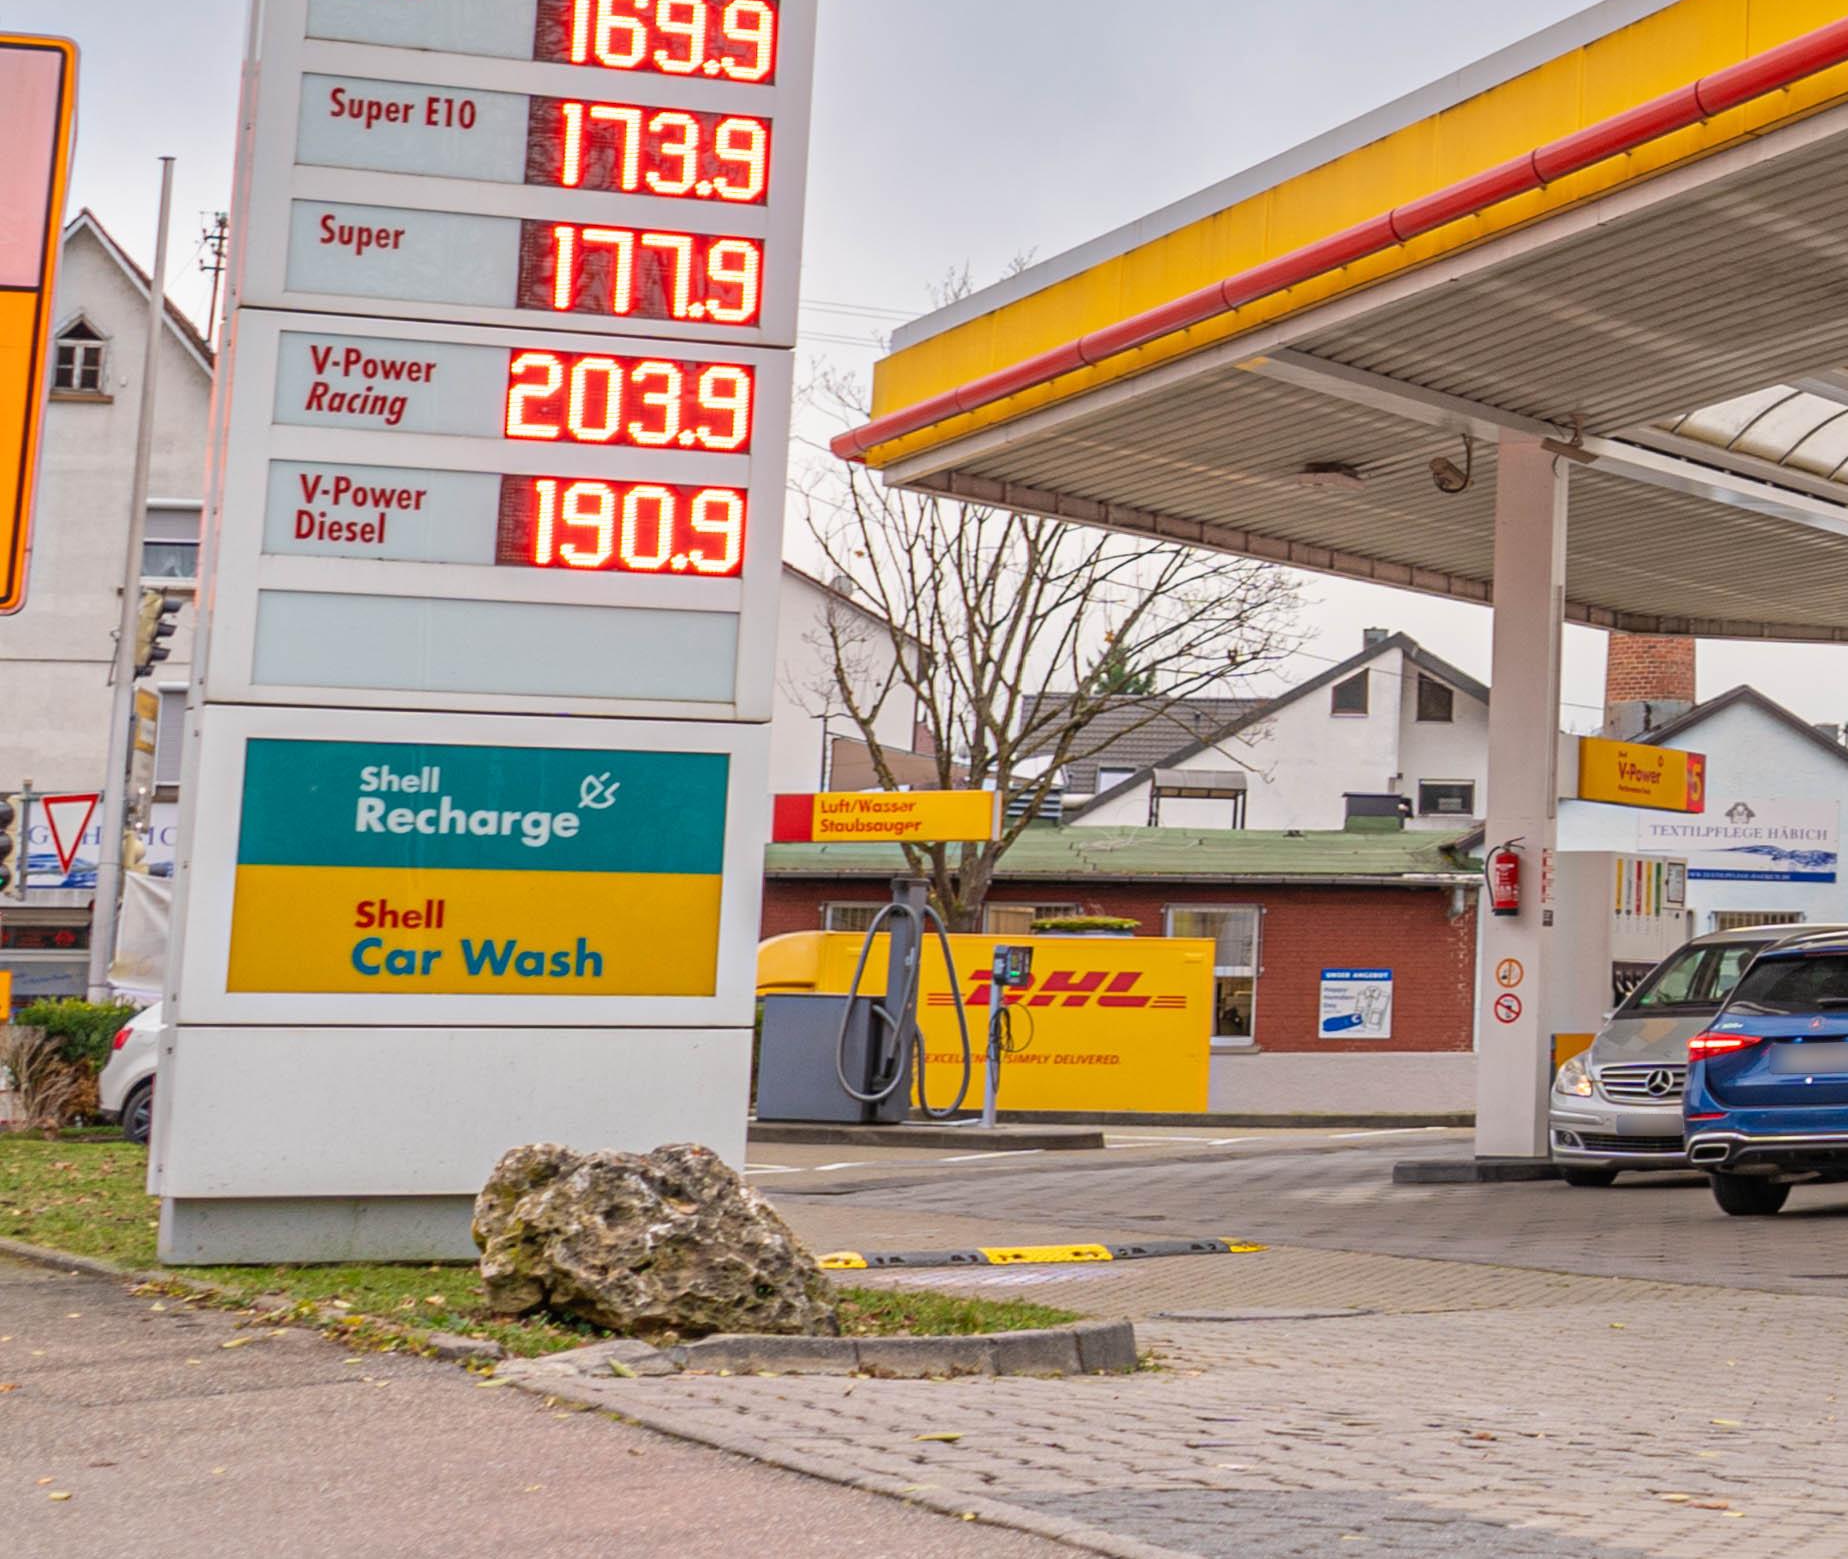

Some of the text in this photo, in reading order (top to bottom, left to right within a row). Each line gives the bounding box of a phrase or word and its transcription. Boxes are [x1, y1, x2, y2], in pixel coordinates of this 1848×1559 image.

[329, 88, 477, 130] Super E10
[560, 102, 769, 201] 173.9
[319, 214, 406, 256] Super
[552, 224, 762, 322] 177.9
[310, 345, 437, 383] V-Power
[304, 382, 408, 426] Racing
[505, 352, 751, 450] 203.9
[299, 473, 427, 511] V-Power
[293, 509, 387, 545] Diesel
[533, 478, 745, 573] 190.9
[359, 765, 441, 794] Shell
[1690, 762, 1701, 802] 5
[355, 795, 581, 848] Recharge
[820, 798, 917, 814] Luft/Wasser
[819, 817, 923, 836] Staubsauger
[1650, 823, 1828, 840] TEXTILPFLEGE HÄBICH
[355, 899, 445, 929] Shell
[351, 937, 604, 978] Car Wash
[964, 970, 1152, 1008] DHL
[1005, 1054, 1051, 1065] SIMPLY
